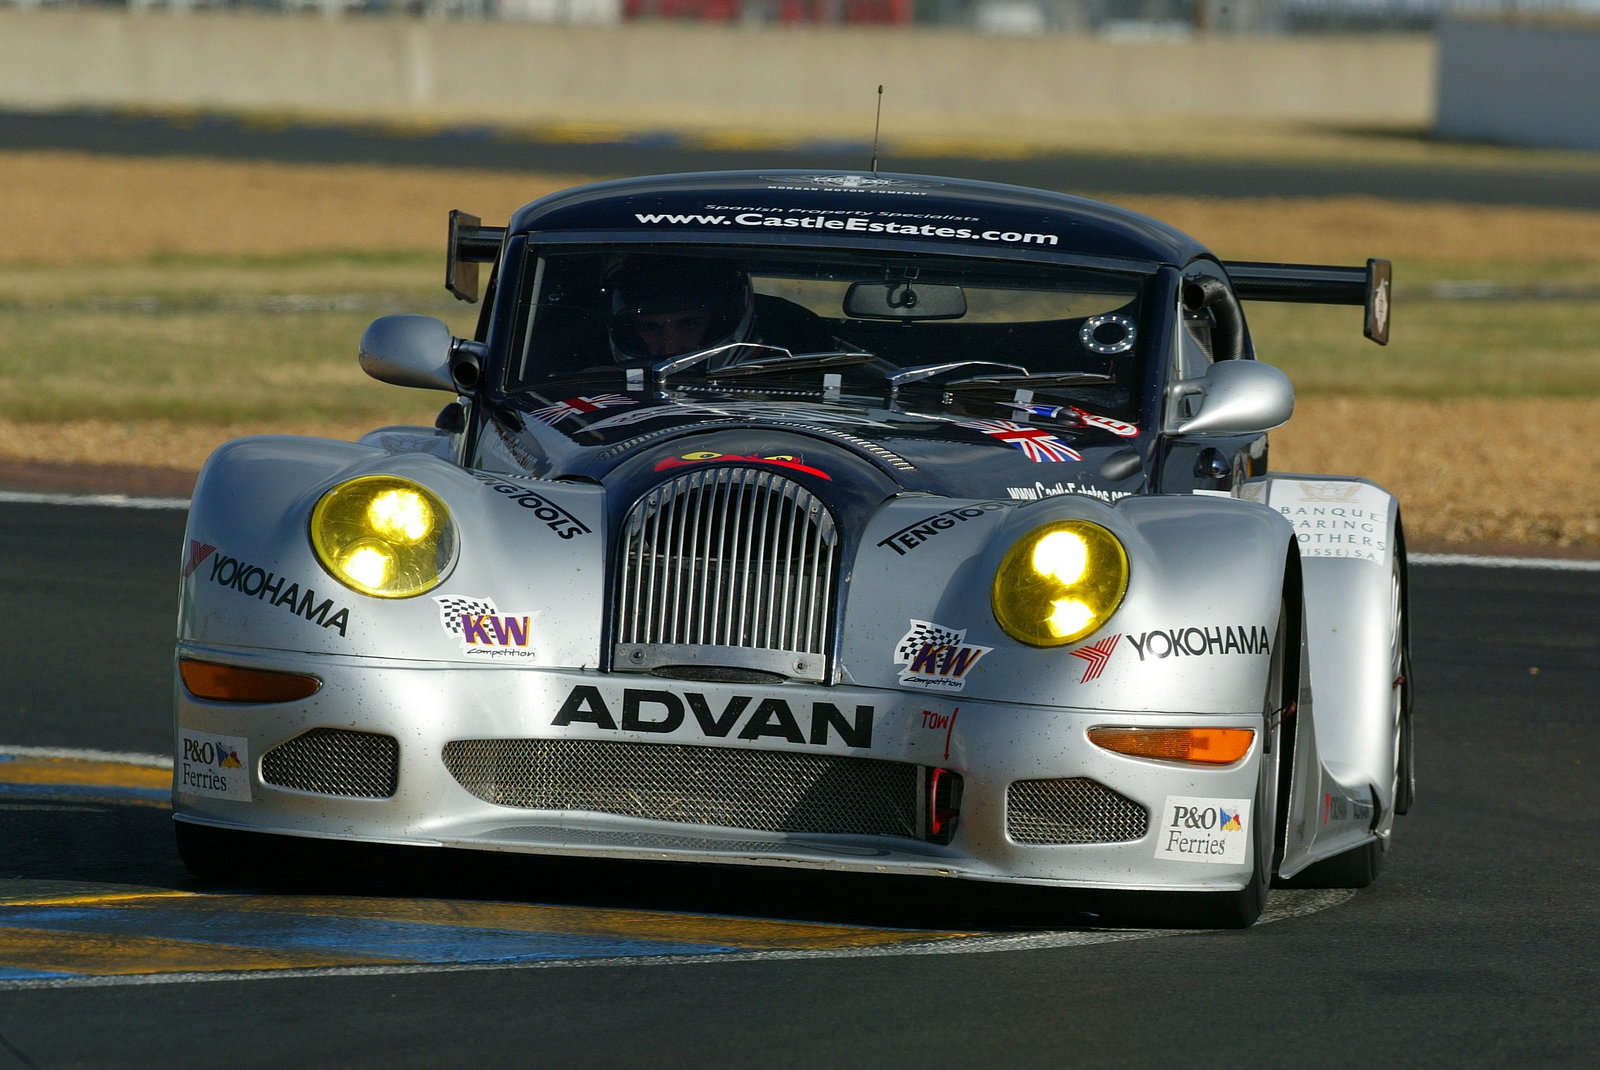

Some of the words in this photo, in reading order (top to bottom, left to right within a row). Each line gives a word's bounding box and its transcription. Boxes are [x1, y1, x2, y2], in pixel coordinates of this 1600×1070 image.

[704, 204, 784, 213] Spanish
[787, 208, 873, 216] Property
[877, 211, 981, 222] Specialists
[634, 212, 1059, 246] www.CastleEstates.com
[1281, 506, 1380, 522] BANQUE
[1297, 533, 1386, 551] OTHERS
[209, 553, 350, 637] YOKOHAMA
[1126, 625, 1270, 662] YOKOHAMA
[550, 684, 875, 749] ADVAN
[921, 710, 949, 730] TOW
[183, 738, 215, 765] P&O
[182, 763, 228, 792] Ferries
[1170, 806, 1217, 830] P&O
[1165, 830, 1226, 855] Ferries
